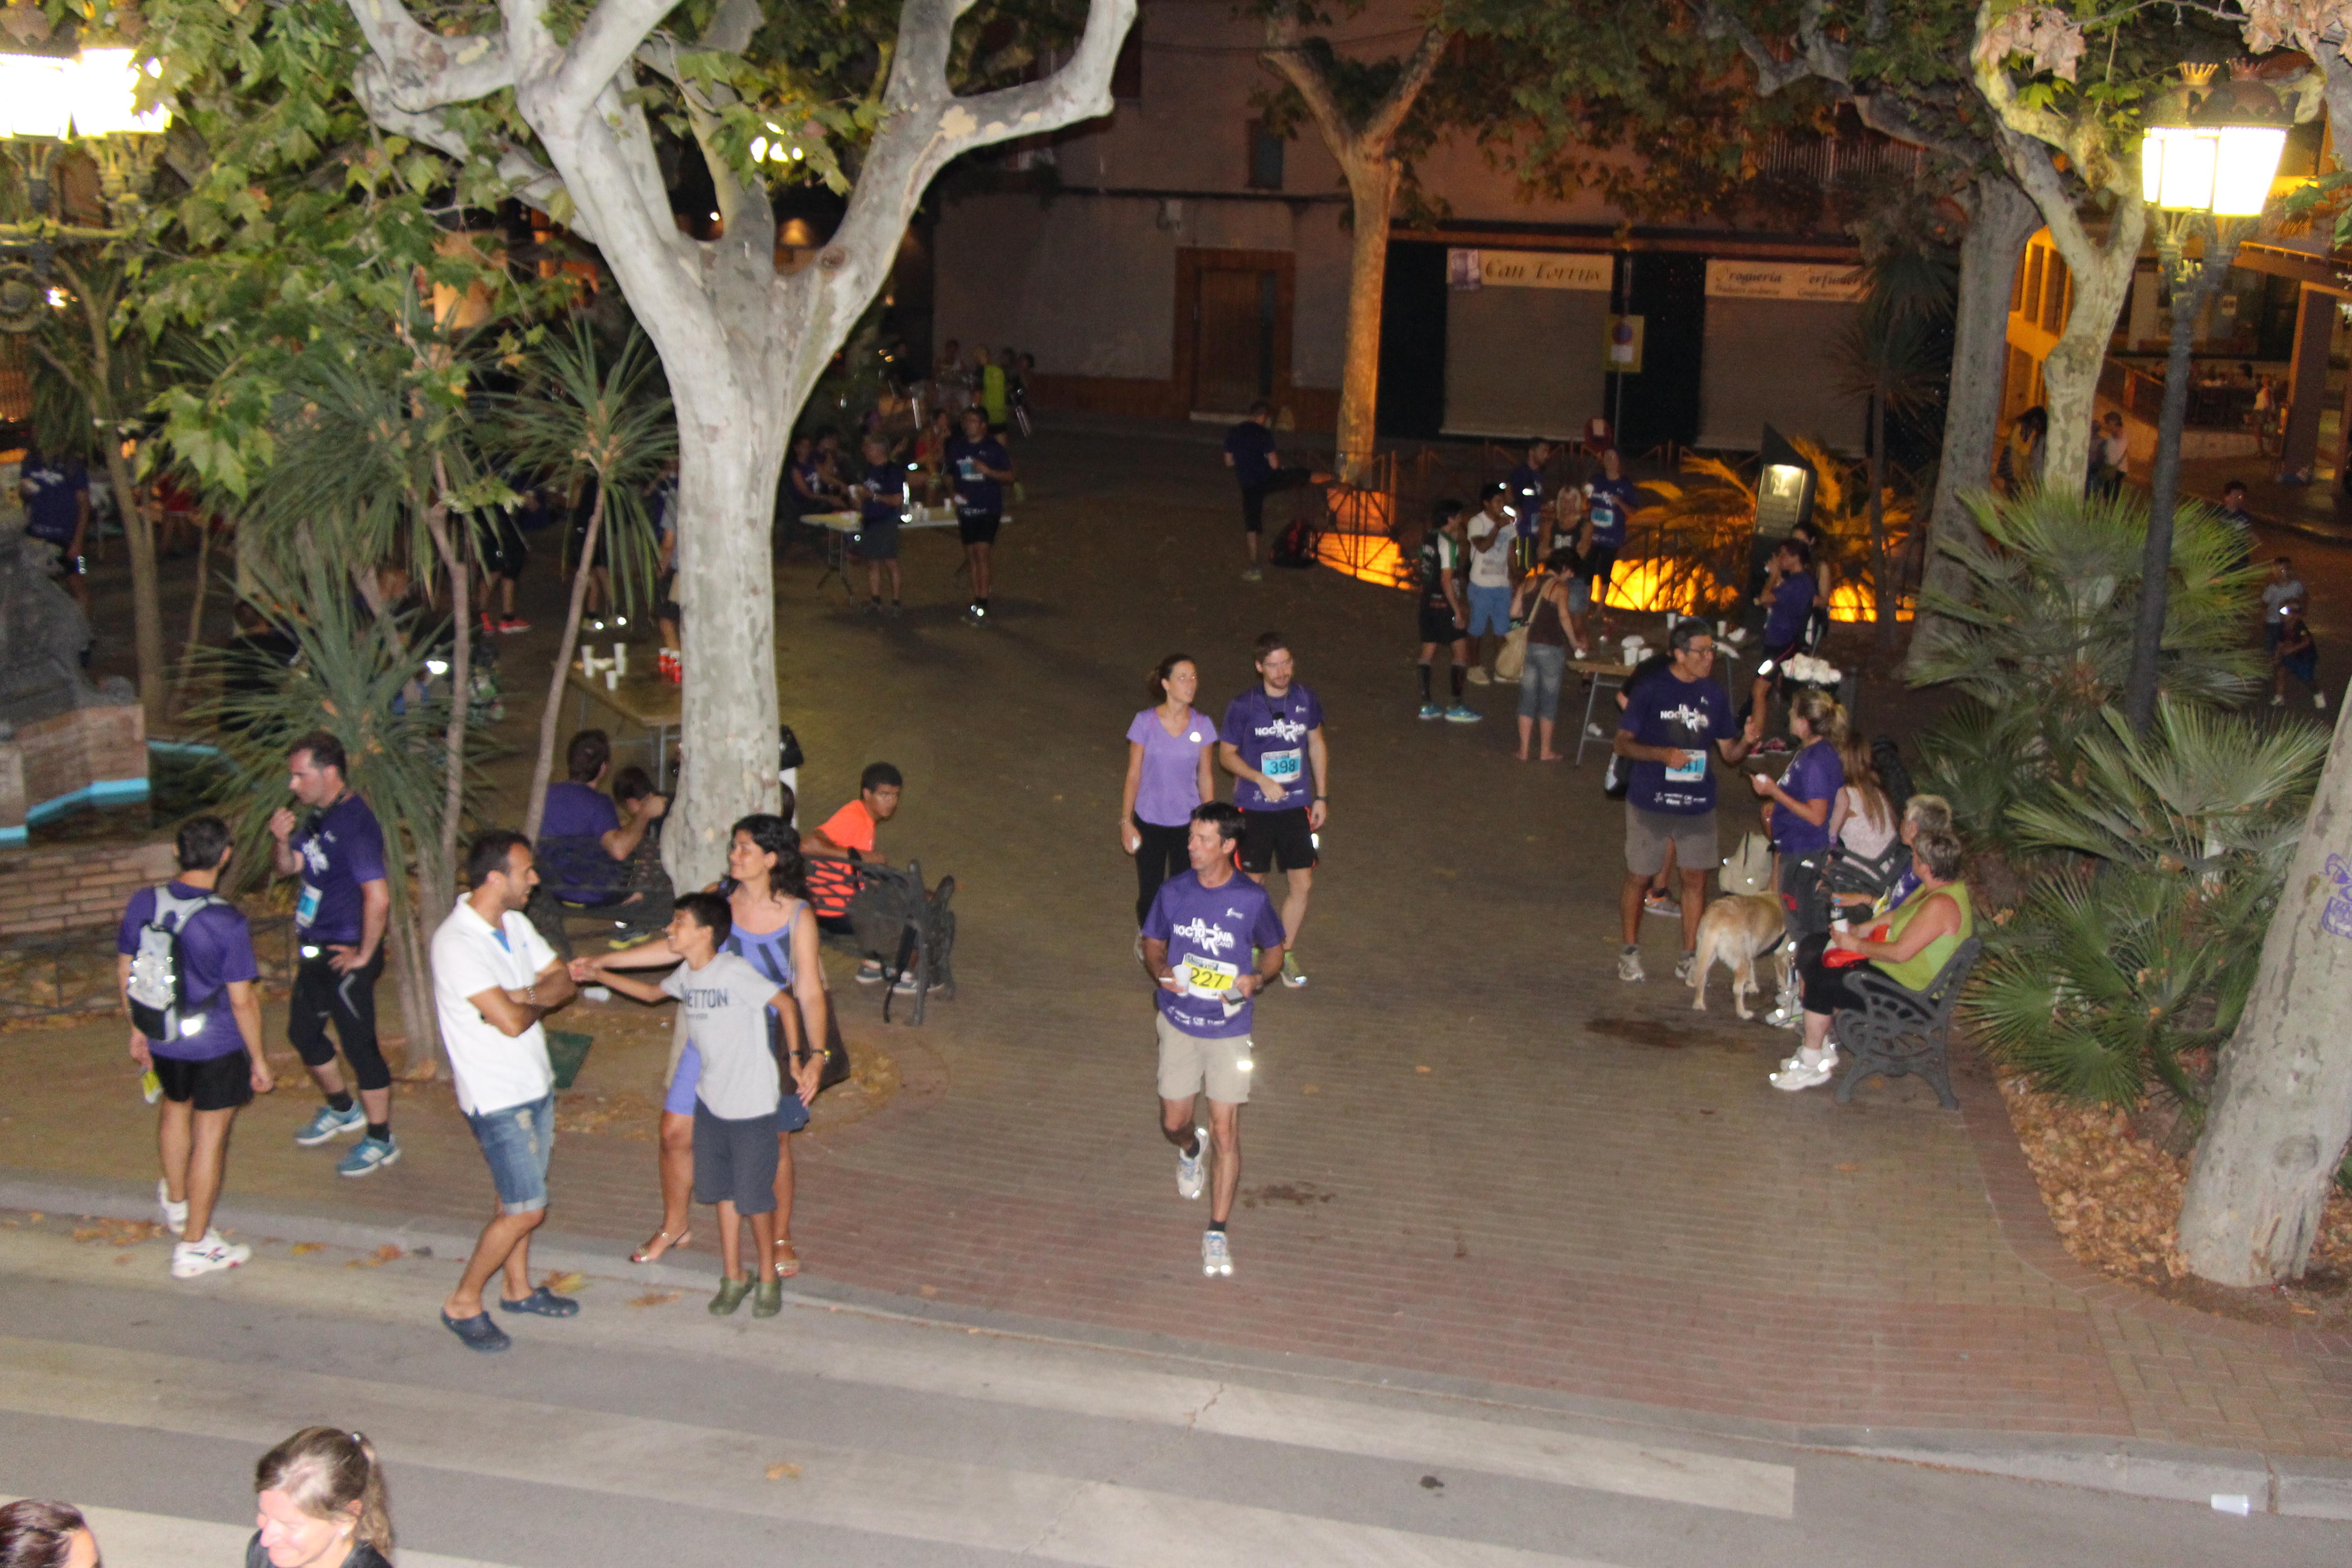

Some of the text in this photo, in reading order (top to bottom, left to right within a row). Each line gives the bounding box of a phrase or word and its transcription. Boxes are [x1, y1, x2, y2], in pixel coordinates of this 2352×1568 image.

[1485, 258, 1524, 279] Can
[1270, 760, 1295, 774] 398
[1191, 917, 1207, 930] LA
[1173, 923, 1235, 956] NOCTURNA
[1190, 967, 1225, 988] 227
